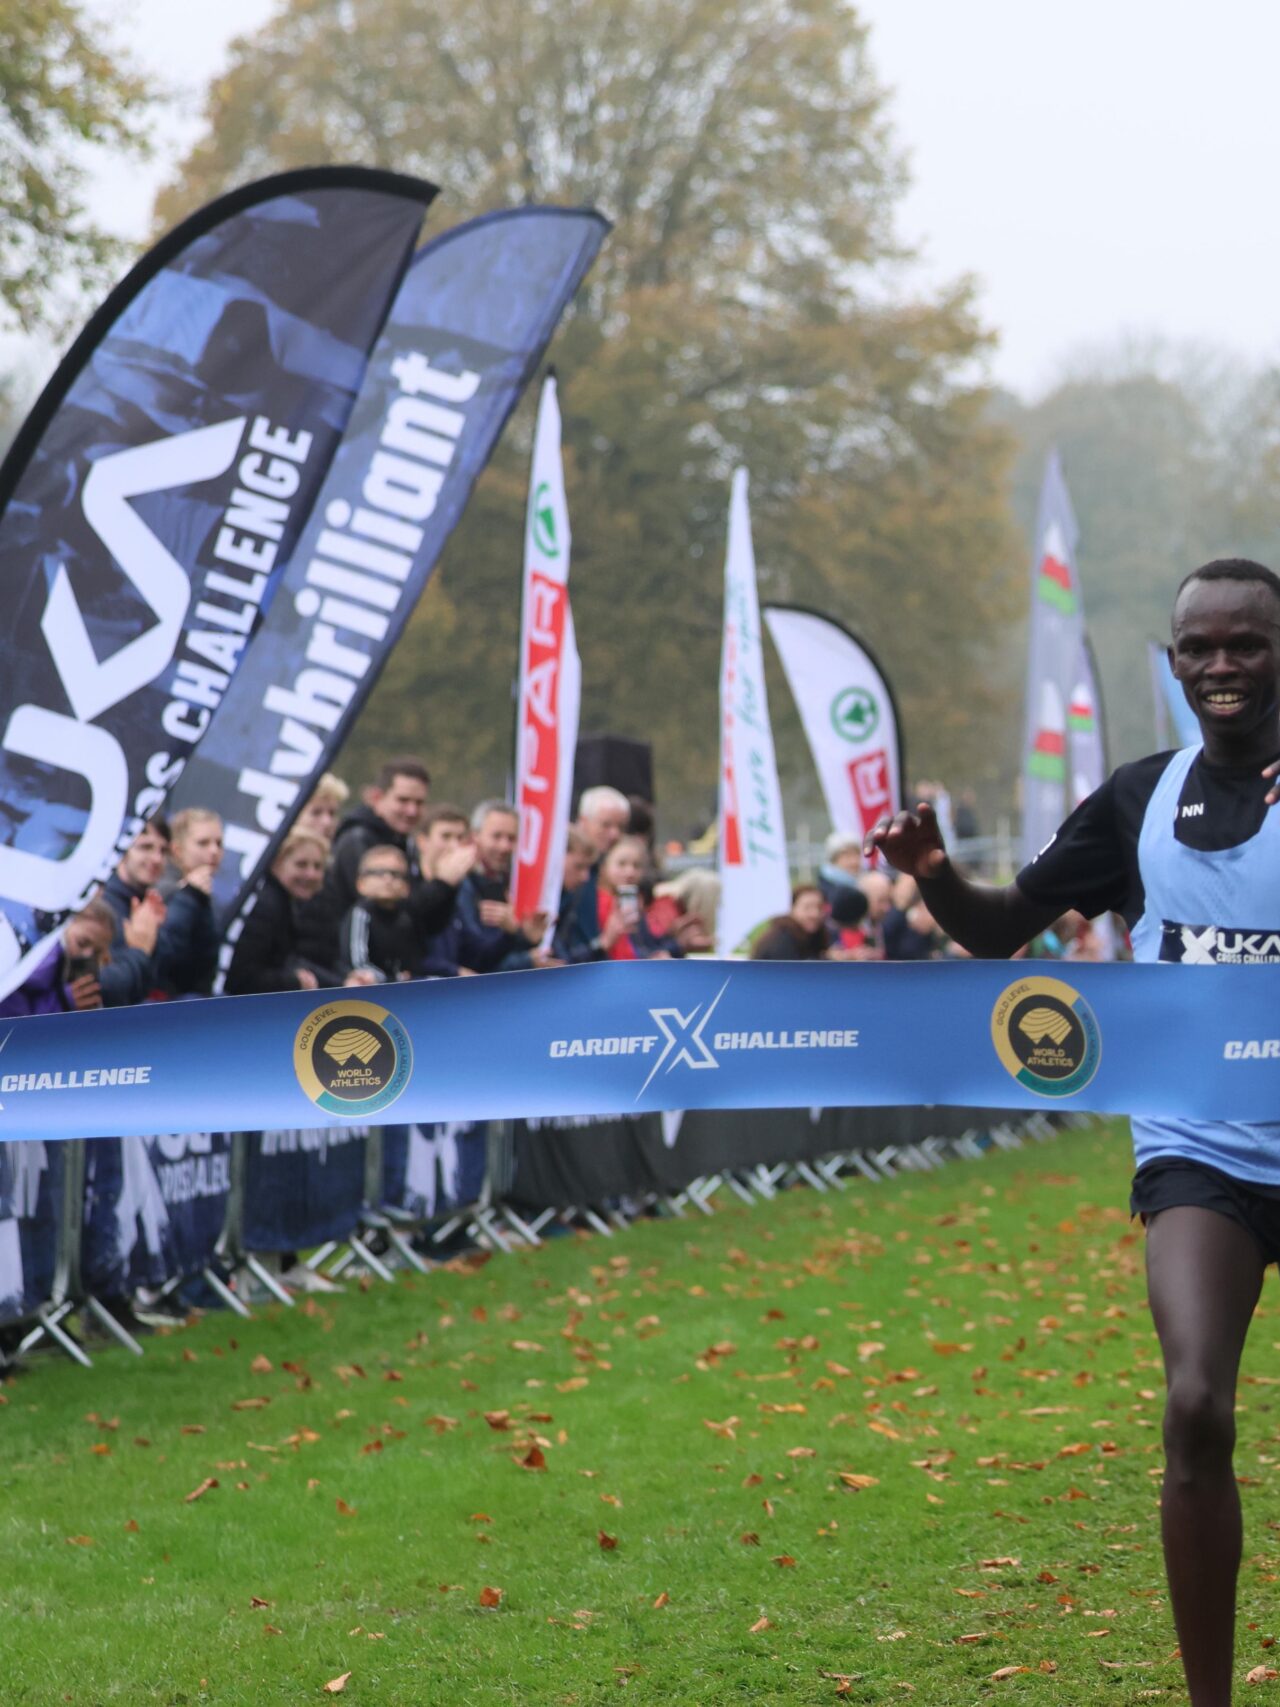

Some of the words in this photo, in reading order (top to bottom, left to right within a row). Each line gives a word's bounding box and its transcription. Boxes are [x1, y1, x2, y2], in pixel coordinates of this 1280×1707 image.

[161, 415, 312, 745] CHALLENGE
[1182, 803, 1204, 818] NN
[300, 1025, 313, 1050] GOLD
[311, 1007, 337, 1026] LEVEL
[550, 1035, 658, 1058] CARDIFF
[714, 1030, 858, 1050] CHALLENGE
[1033, 1048, 1065, 1057] WORLD
[1027, 1057, 1074, 1067] ATHLETICS
[1, 1066, 152, 1092] CHALLENGE
[337, 1068, 372, 1078] WORLD
[330, 1076, 381, 1088] ATHLETICS
